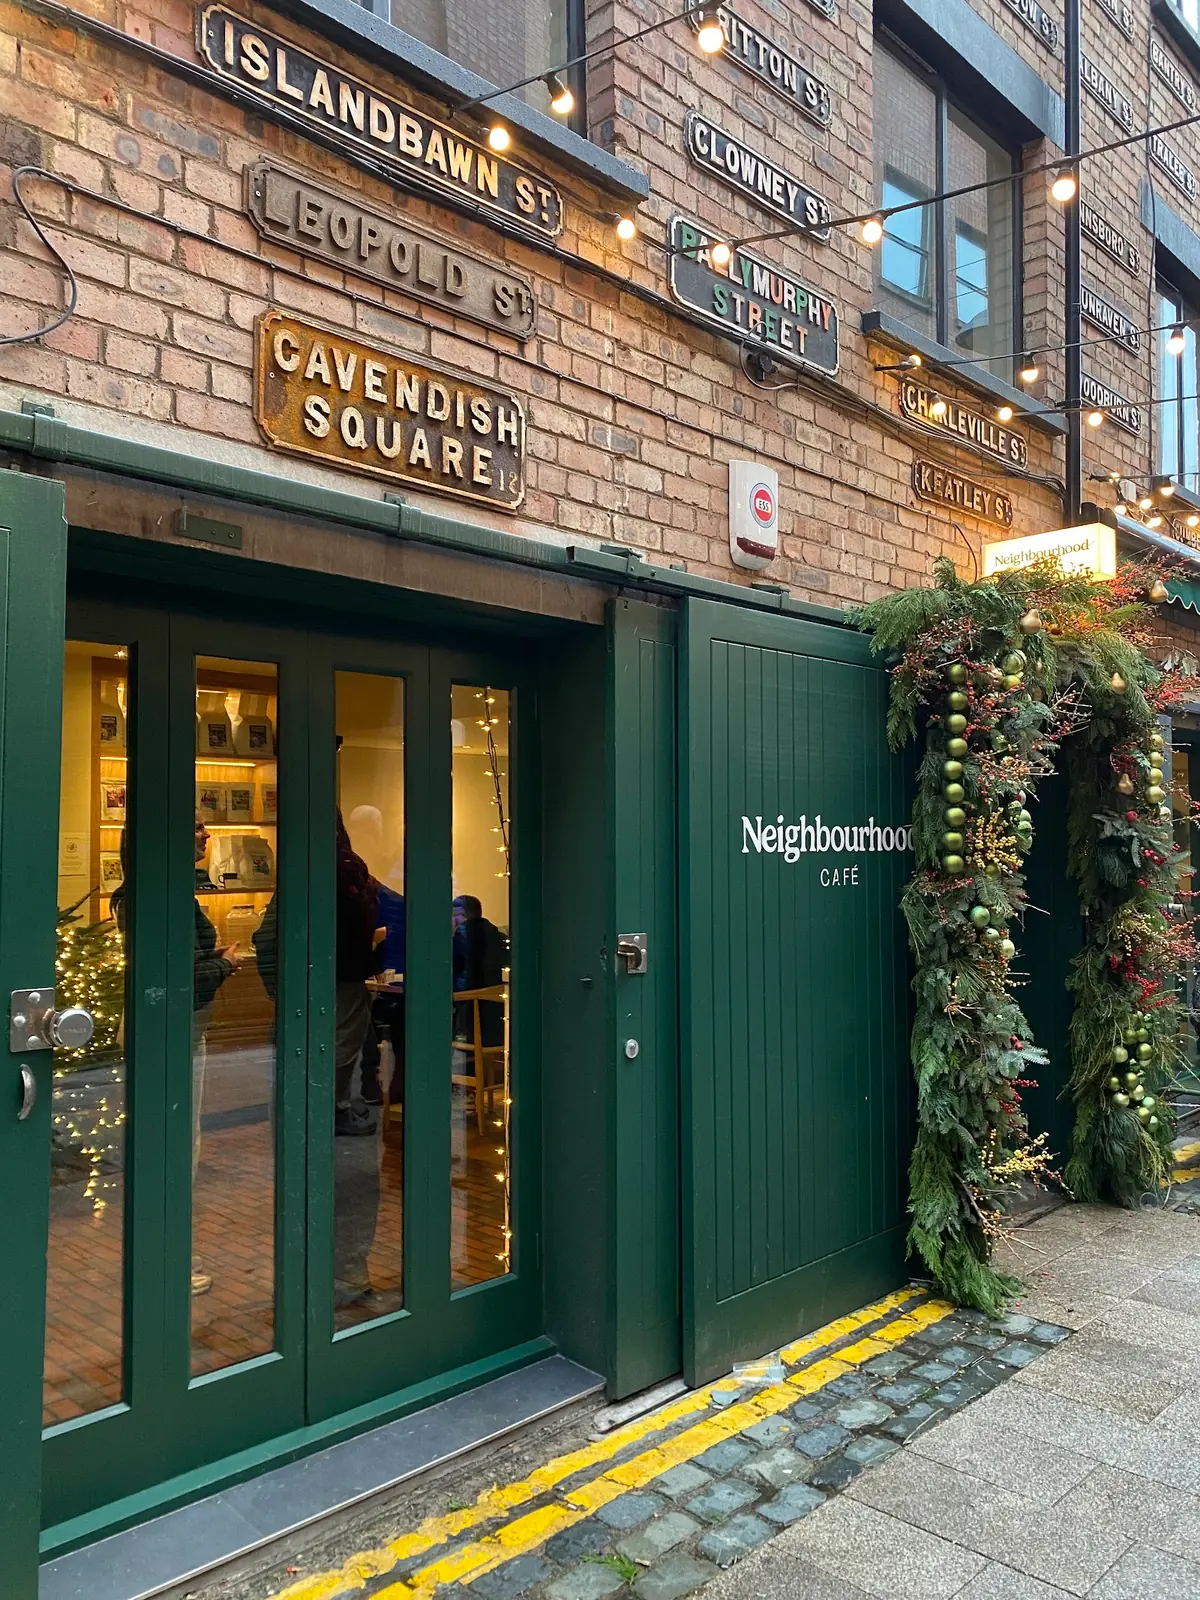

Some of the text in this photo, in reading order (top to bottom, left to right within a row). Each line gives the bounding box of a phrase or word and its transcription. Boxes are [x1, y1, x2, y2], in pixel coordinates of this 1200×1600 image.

[699, 7, 797, 93] RITTON
[222, 20, 551, 223] ISLANDBAWN ST
[694, 122, 799, 212] CLOWNEY
[263, 170, 530, 318] LEOPOLD ST
[712, 283, 808, 354] STREET
[1081, 289, 1126, 336] UNRAVEN
[273, 329, 518, 446] CAVENDISH
[1083, 377, 1129, 422] OODBURN
[303, 394, 493, 486] SQUARE
[758, 500, 769, 511] ESS
[921, 465, 991, 515] KEATLEY
[994, 539, 1091, 566] Neighbourhood
[820, 864, 859, 887] CAFÉ
